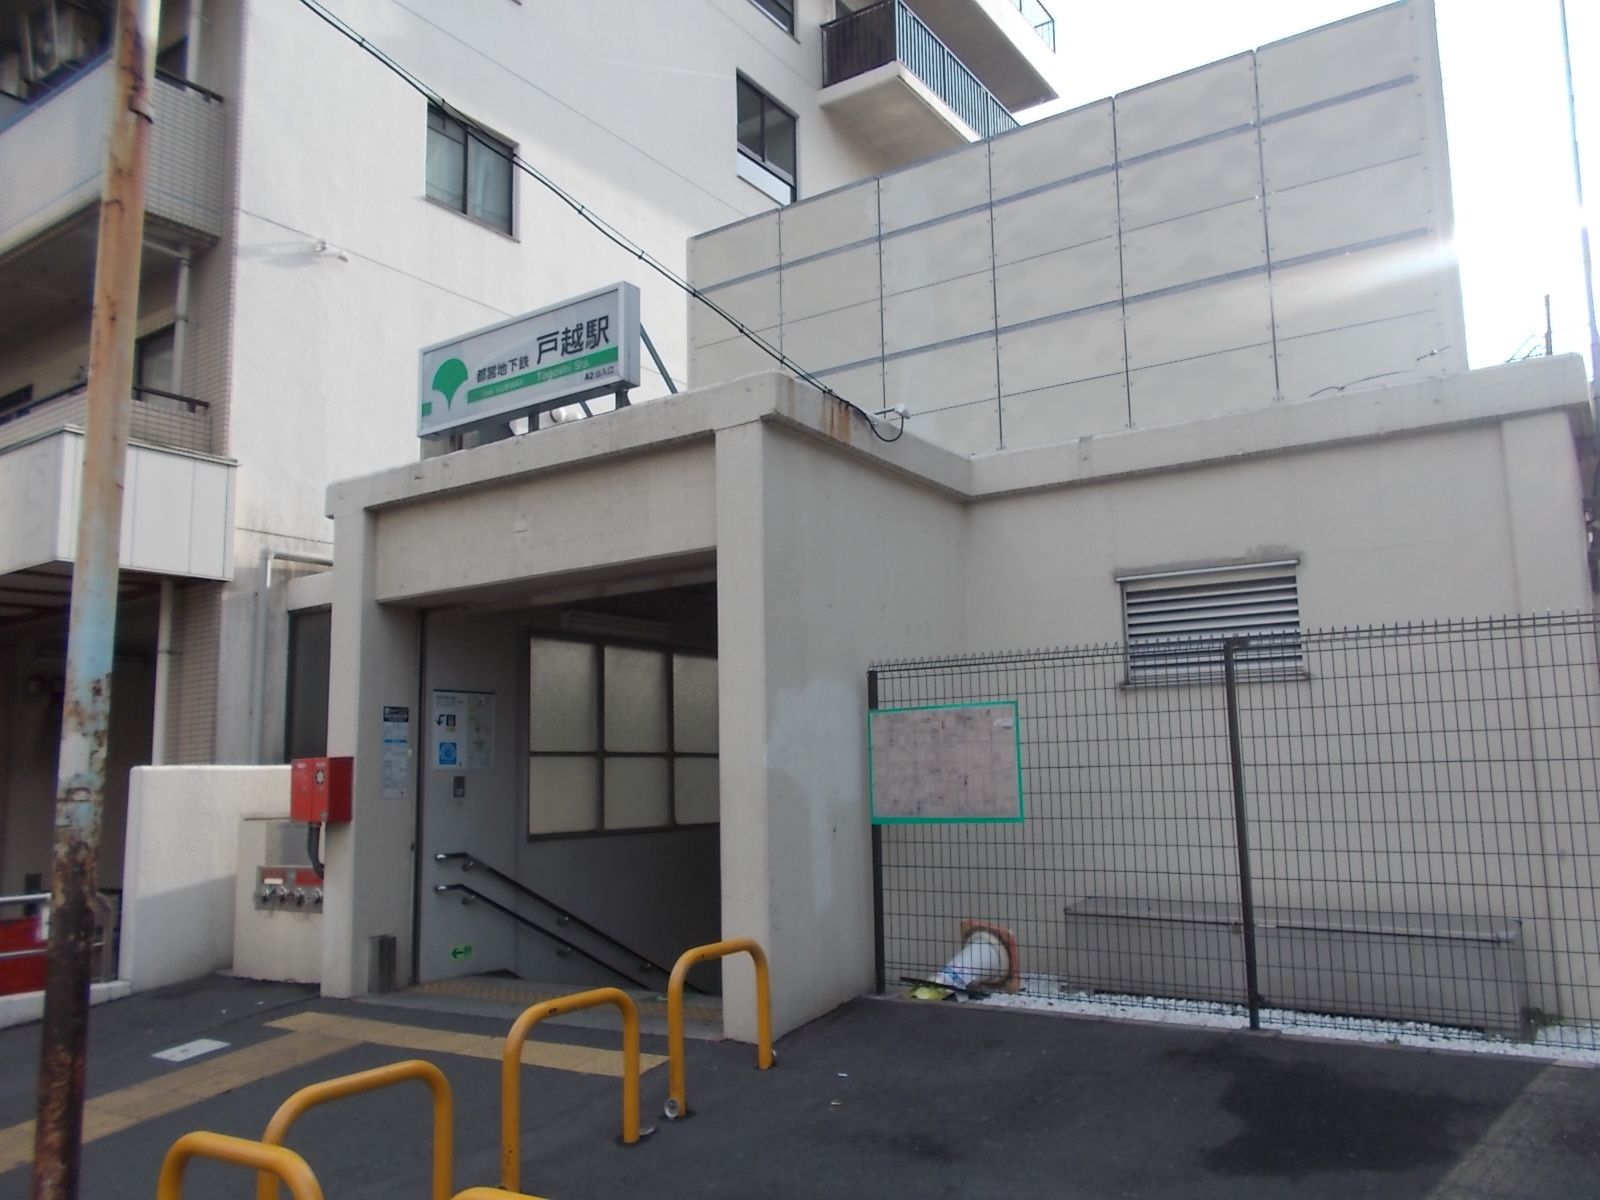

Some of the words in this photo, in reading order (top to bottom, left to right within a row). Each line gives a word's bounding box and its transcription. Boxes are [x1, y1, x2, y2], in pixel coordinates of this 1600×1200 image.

[477, 355, 530, 383] 都営地下鉄
[536, 315, 609, 365] 戸越駅
